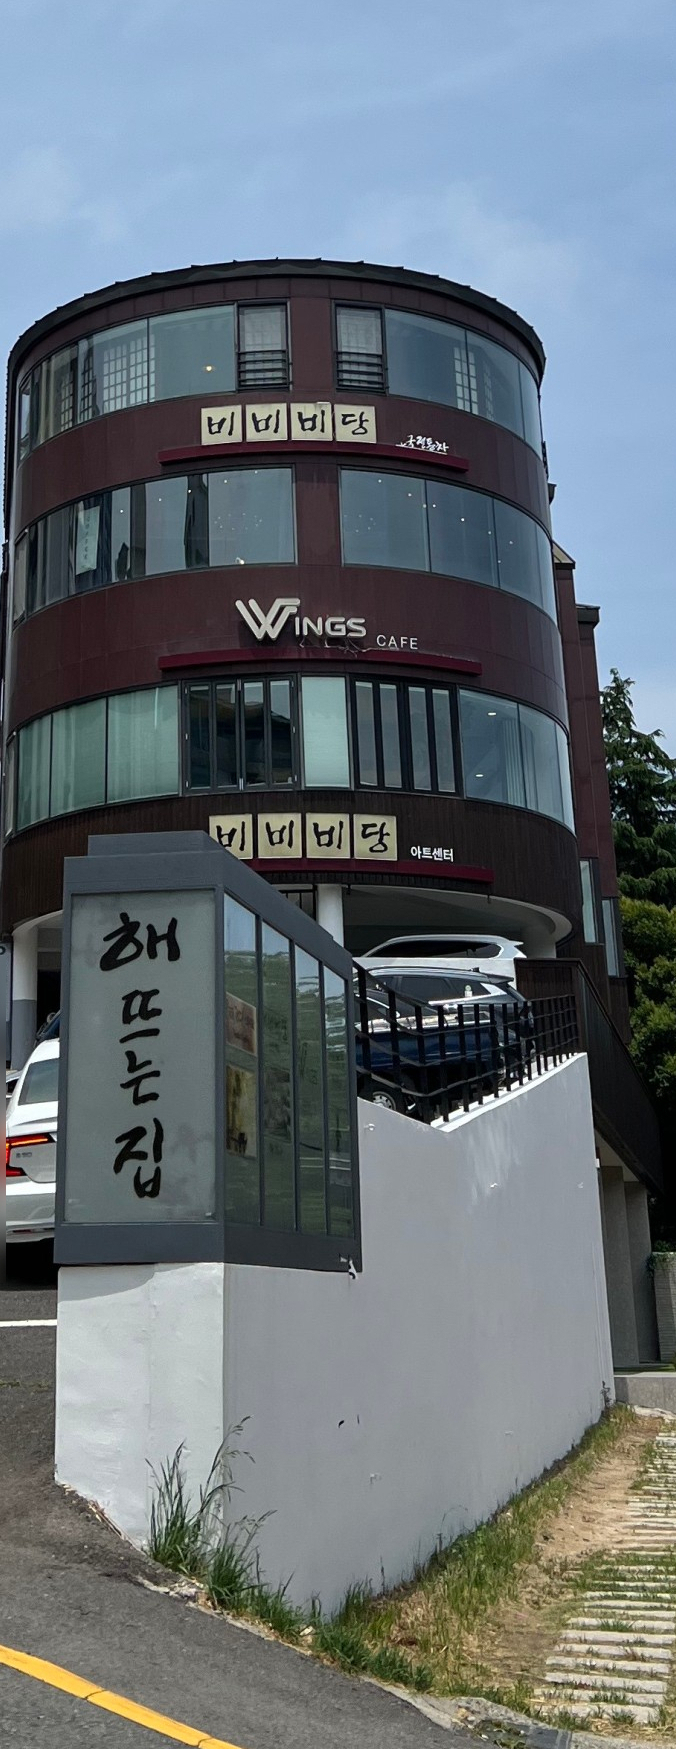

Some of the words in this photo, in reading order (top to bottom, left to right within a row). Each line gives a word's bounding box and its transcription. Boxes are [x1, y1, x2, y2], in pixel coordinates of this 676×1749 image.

[206, 409, 370, 437] 비비비당
[235, 597, 367, 641] WINGS
[376, 634, 419, 650] CAFE
[215, 819, 391, 854] 비비비당
[410, 845, 454, 863] 아트센터
